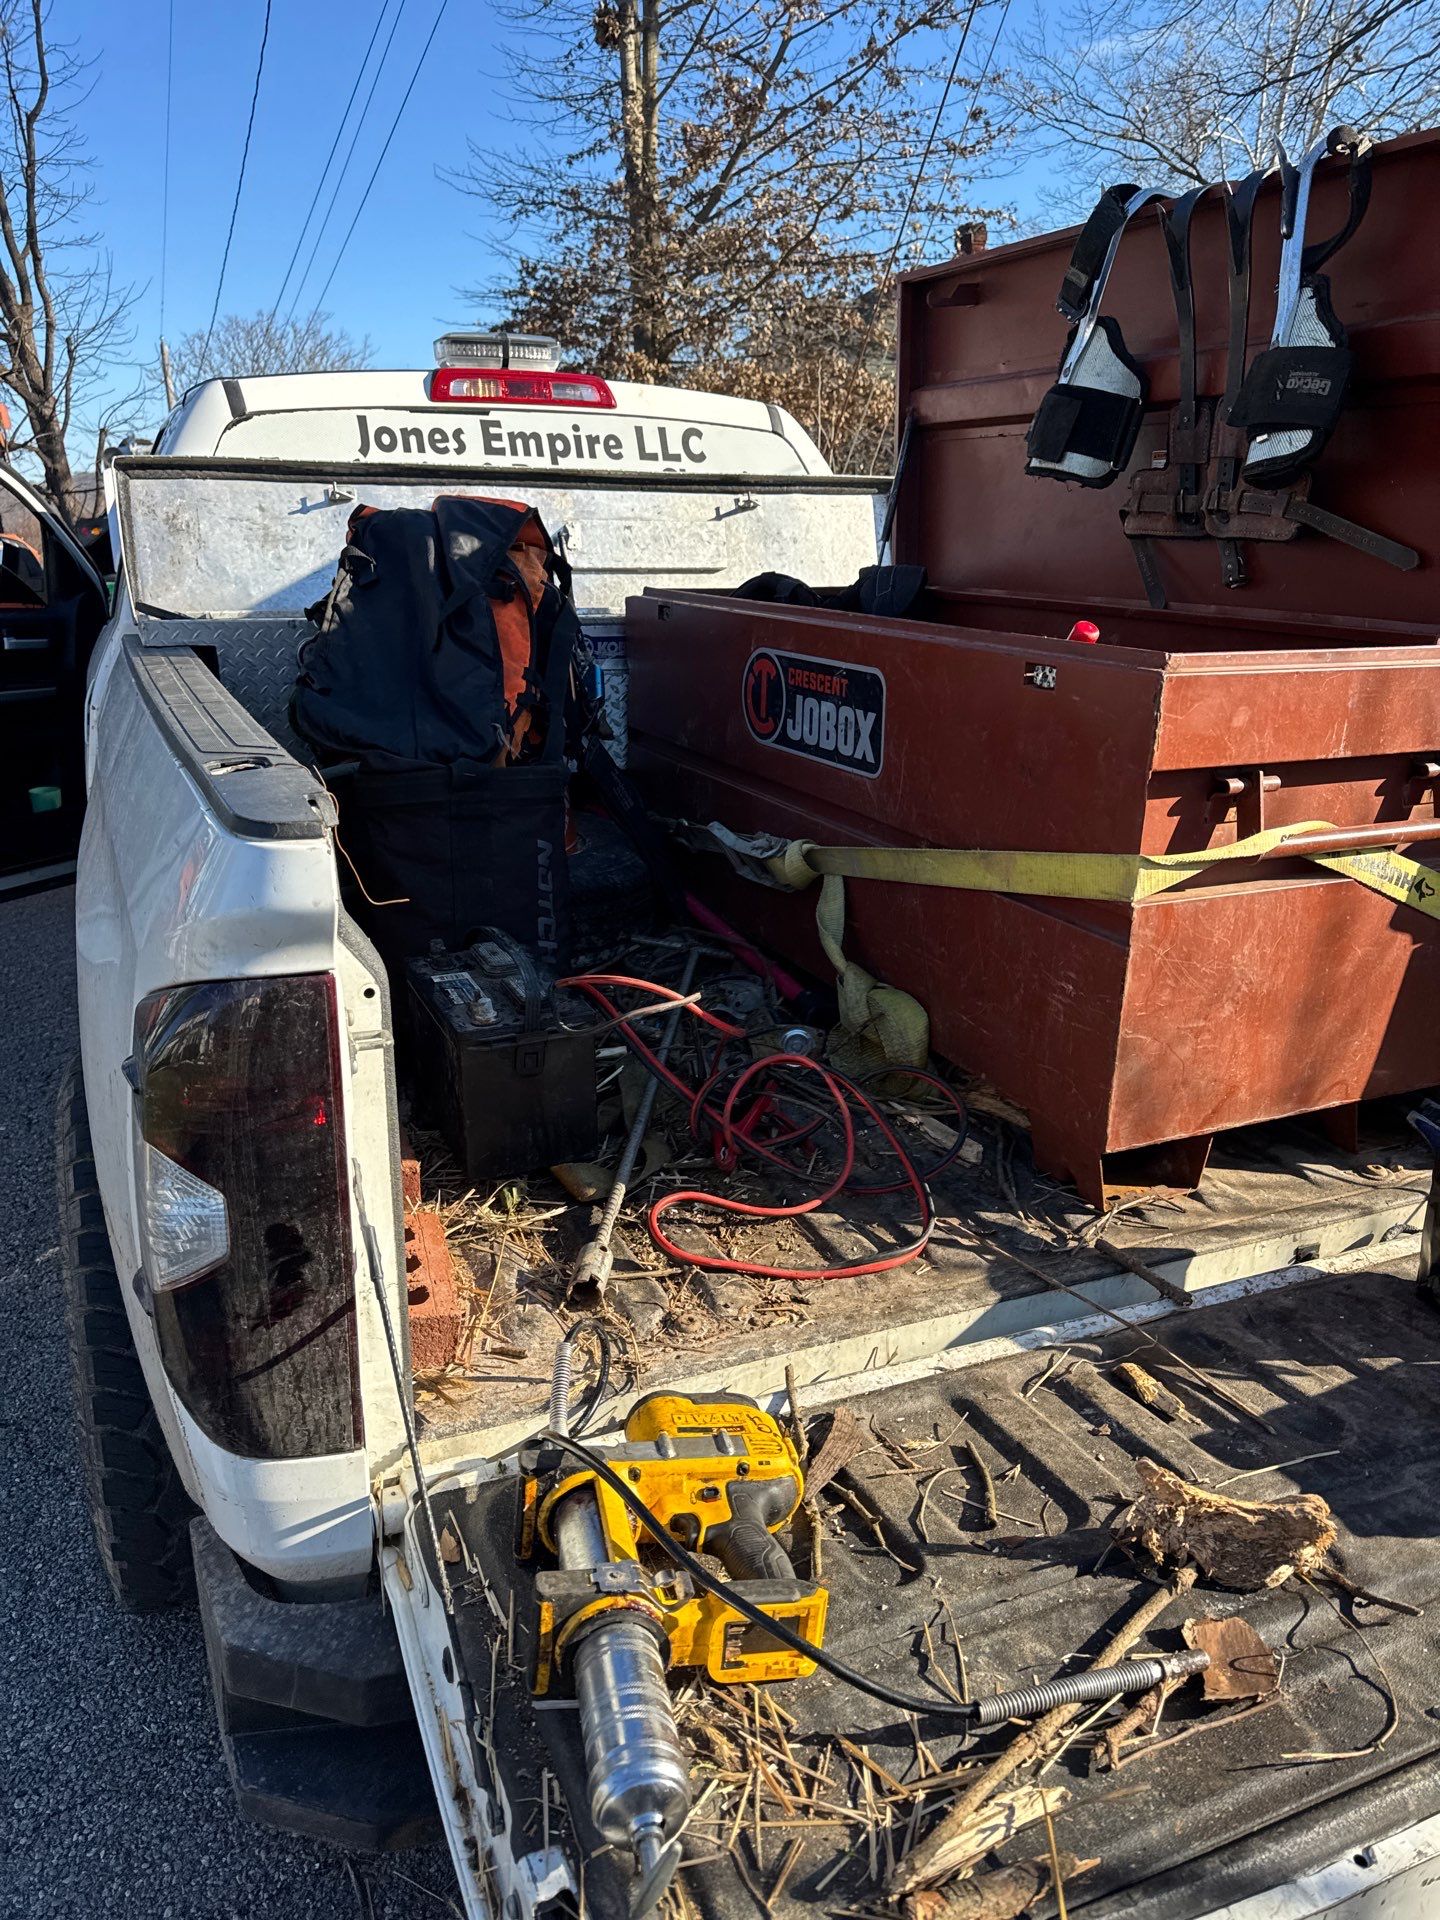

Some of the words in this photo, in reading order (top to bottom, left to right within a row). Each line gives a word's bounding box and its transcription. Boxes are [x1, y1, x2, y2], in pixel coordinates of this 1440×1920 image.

[357, 415, 467, 458] Jones
[479, 418, 624, 466] Empire
[634, 425, 707, 463] LLC
[787, 667, 849, 698] CRESCENT
[786, 694, 877, 764] JOBOX
